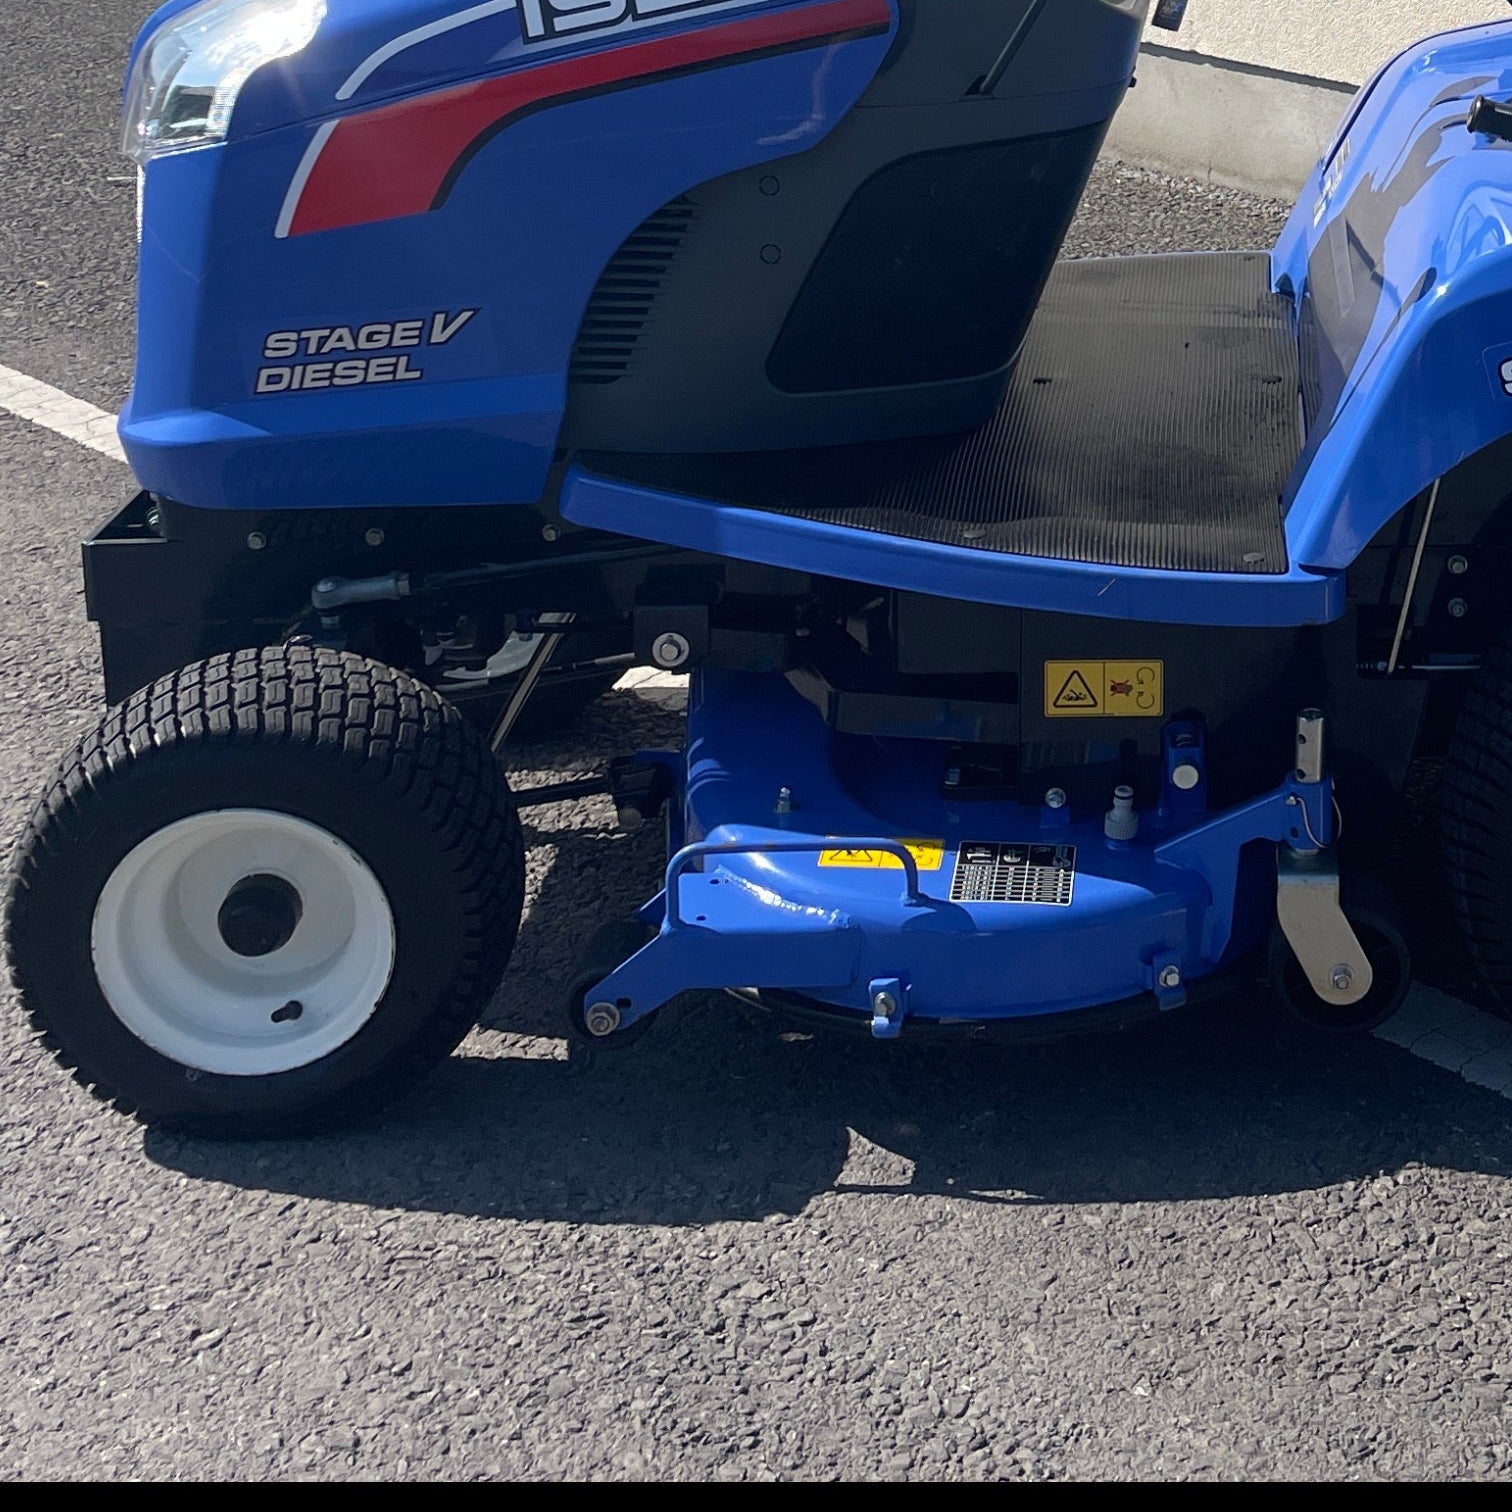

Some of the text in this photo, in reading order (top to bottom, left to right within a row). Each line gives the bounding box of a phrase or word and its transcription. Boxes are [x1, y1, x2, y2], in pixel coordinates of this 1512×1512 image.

[263, 310, 476, 359] STAGE V
[255, 355, 422, 393] DIESEL
